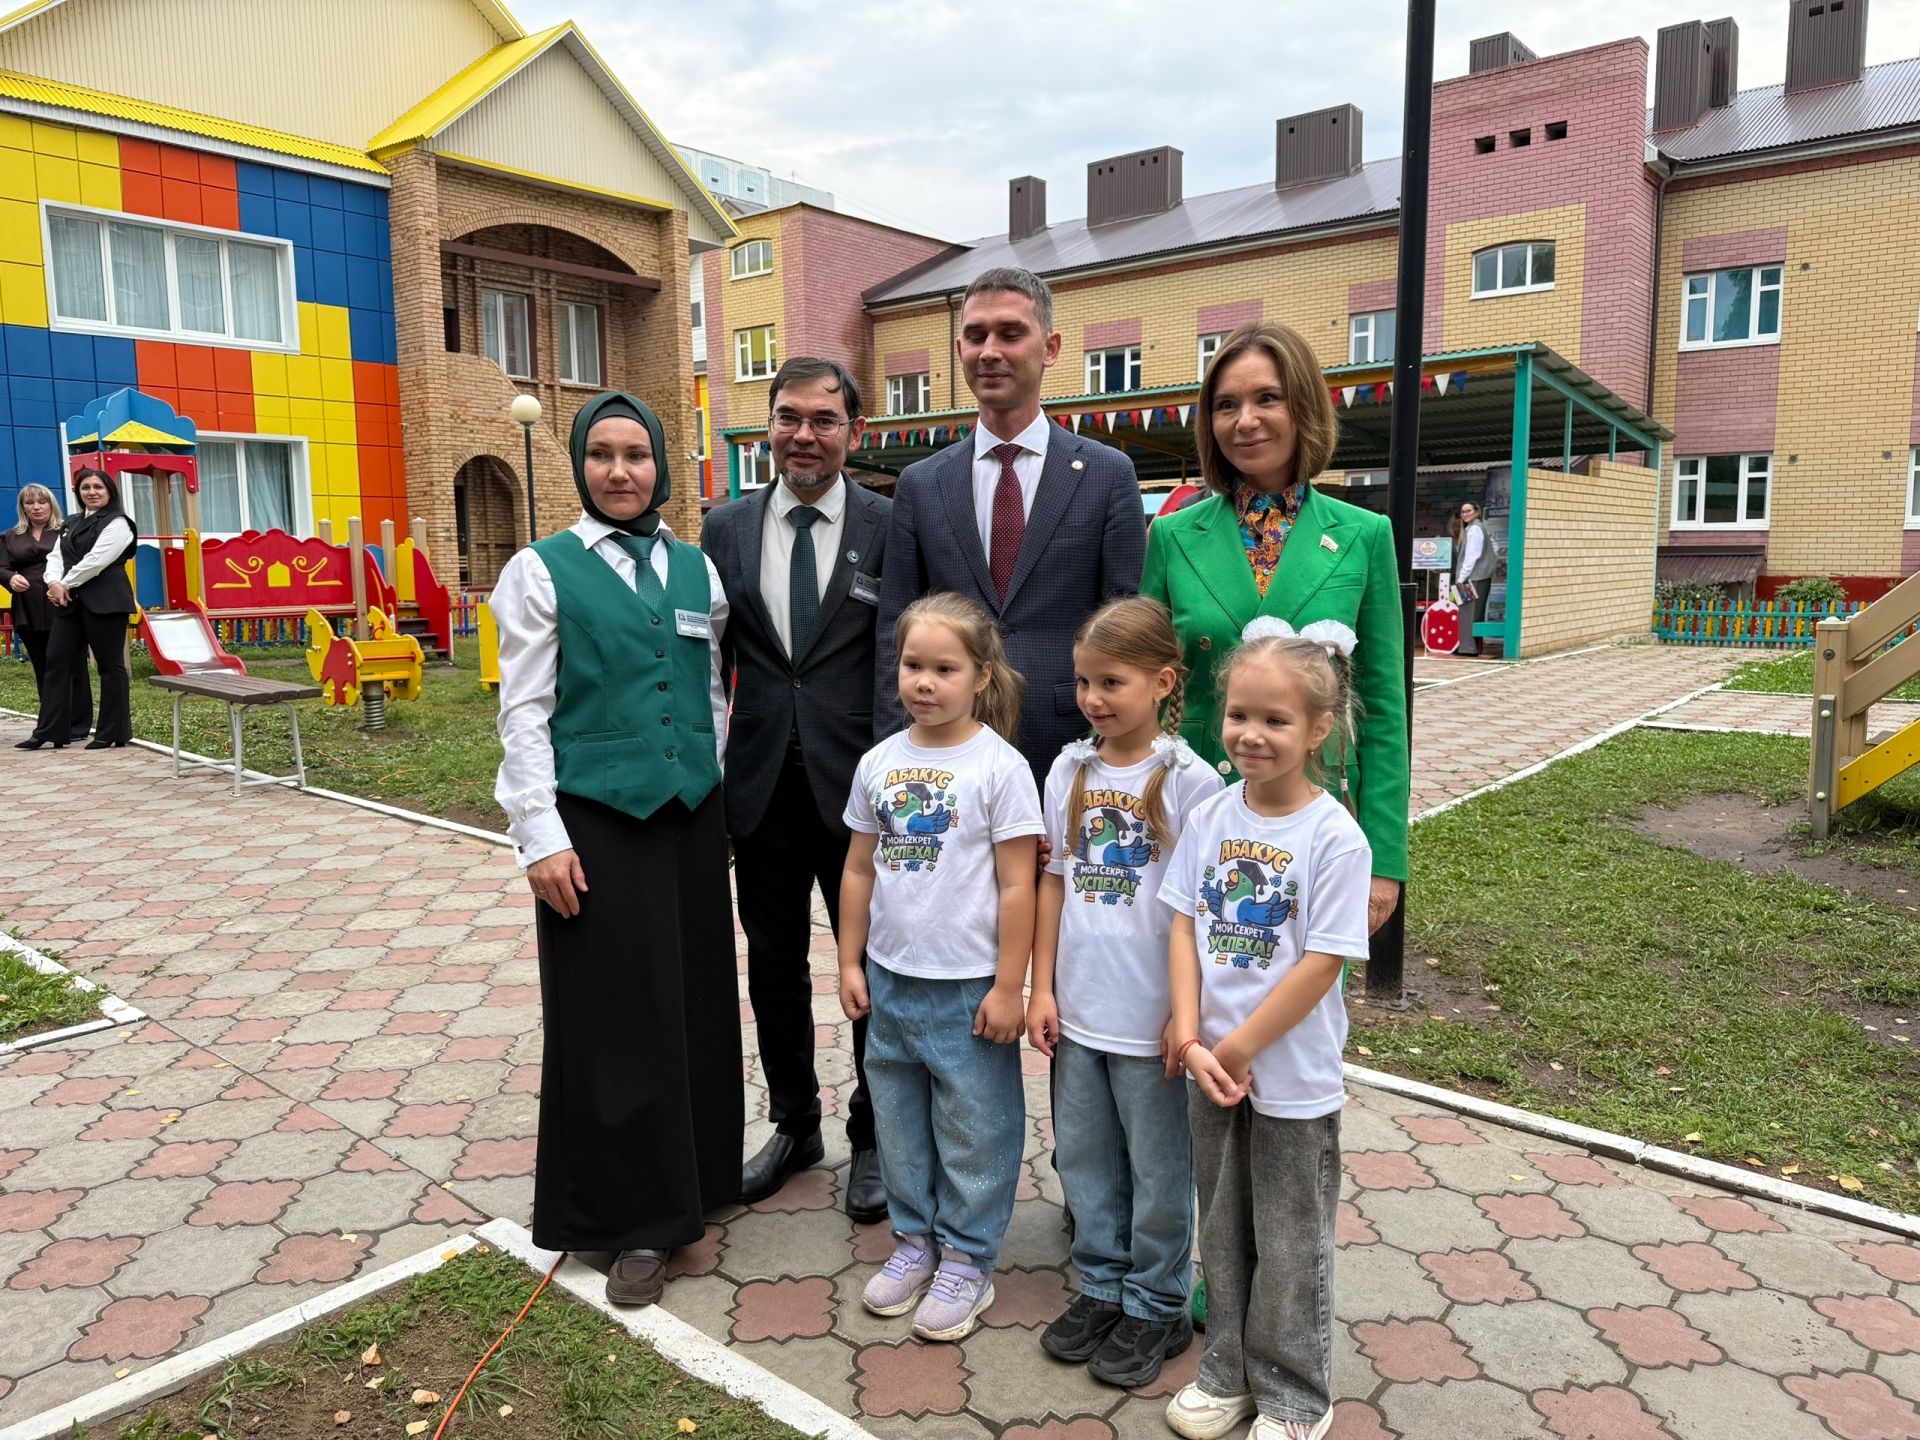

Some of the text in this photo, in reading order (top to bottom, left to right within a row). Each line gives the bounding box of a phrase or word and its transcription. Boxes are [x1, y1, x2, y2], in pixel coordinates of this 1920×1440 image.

[884, 768, 954, 789] АБАКУС
[1082, 789, 1146, 821] АБАКУС
[887, 835, 932, 845] МОЙ СЕКРЕТ
[882, 845, 940, 863] УСПЕХА!
[1219, 839, 1294, 874] АБАКУС
[1080, 865, 1129, 878] МОЙ СЕКРЕТ
[1204, 865, 1215, 880] 5
[1072, 876, 1137, 897] УСПЕХА!
[1284, 880, 1298, 896] 2
[1215, 923, 1265, 939] МОЙ СЕКРЕТ
[1207, 935, 1275, 959] УСПЕХА!
